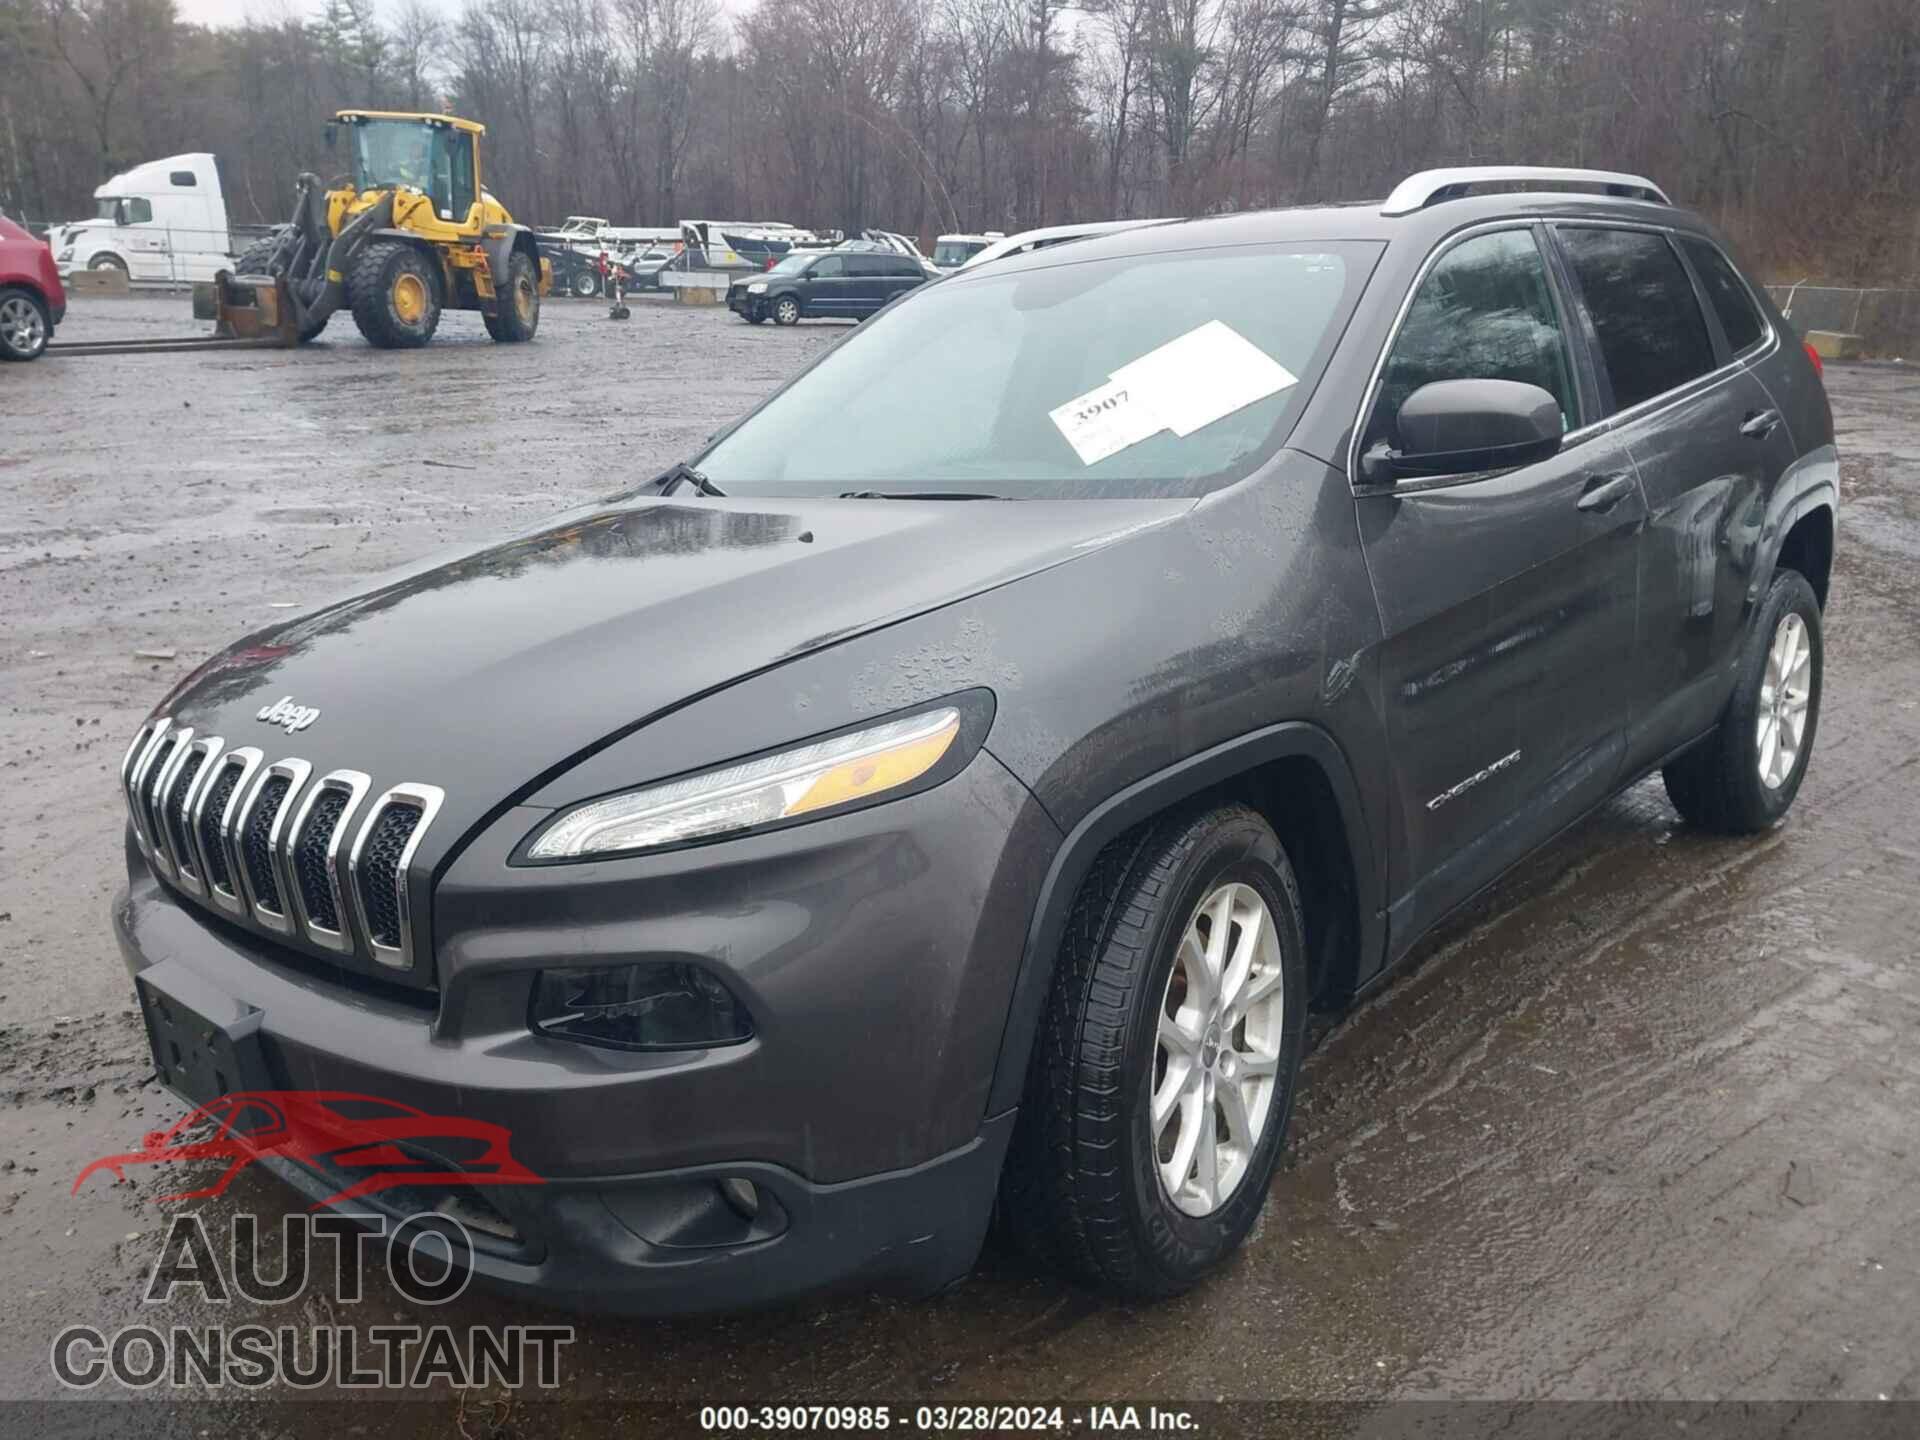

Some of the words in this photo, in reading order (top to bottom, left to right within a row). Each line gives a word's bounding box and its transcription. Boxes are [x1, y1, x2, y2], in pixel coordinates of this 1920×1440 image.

[1073, 389, 1129, 425] 3907
[256, 695, 321, 735] Jeep
[1425, 749, 1521, 810] CHEROKEE
